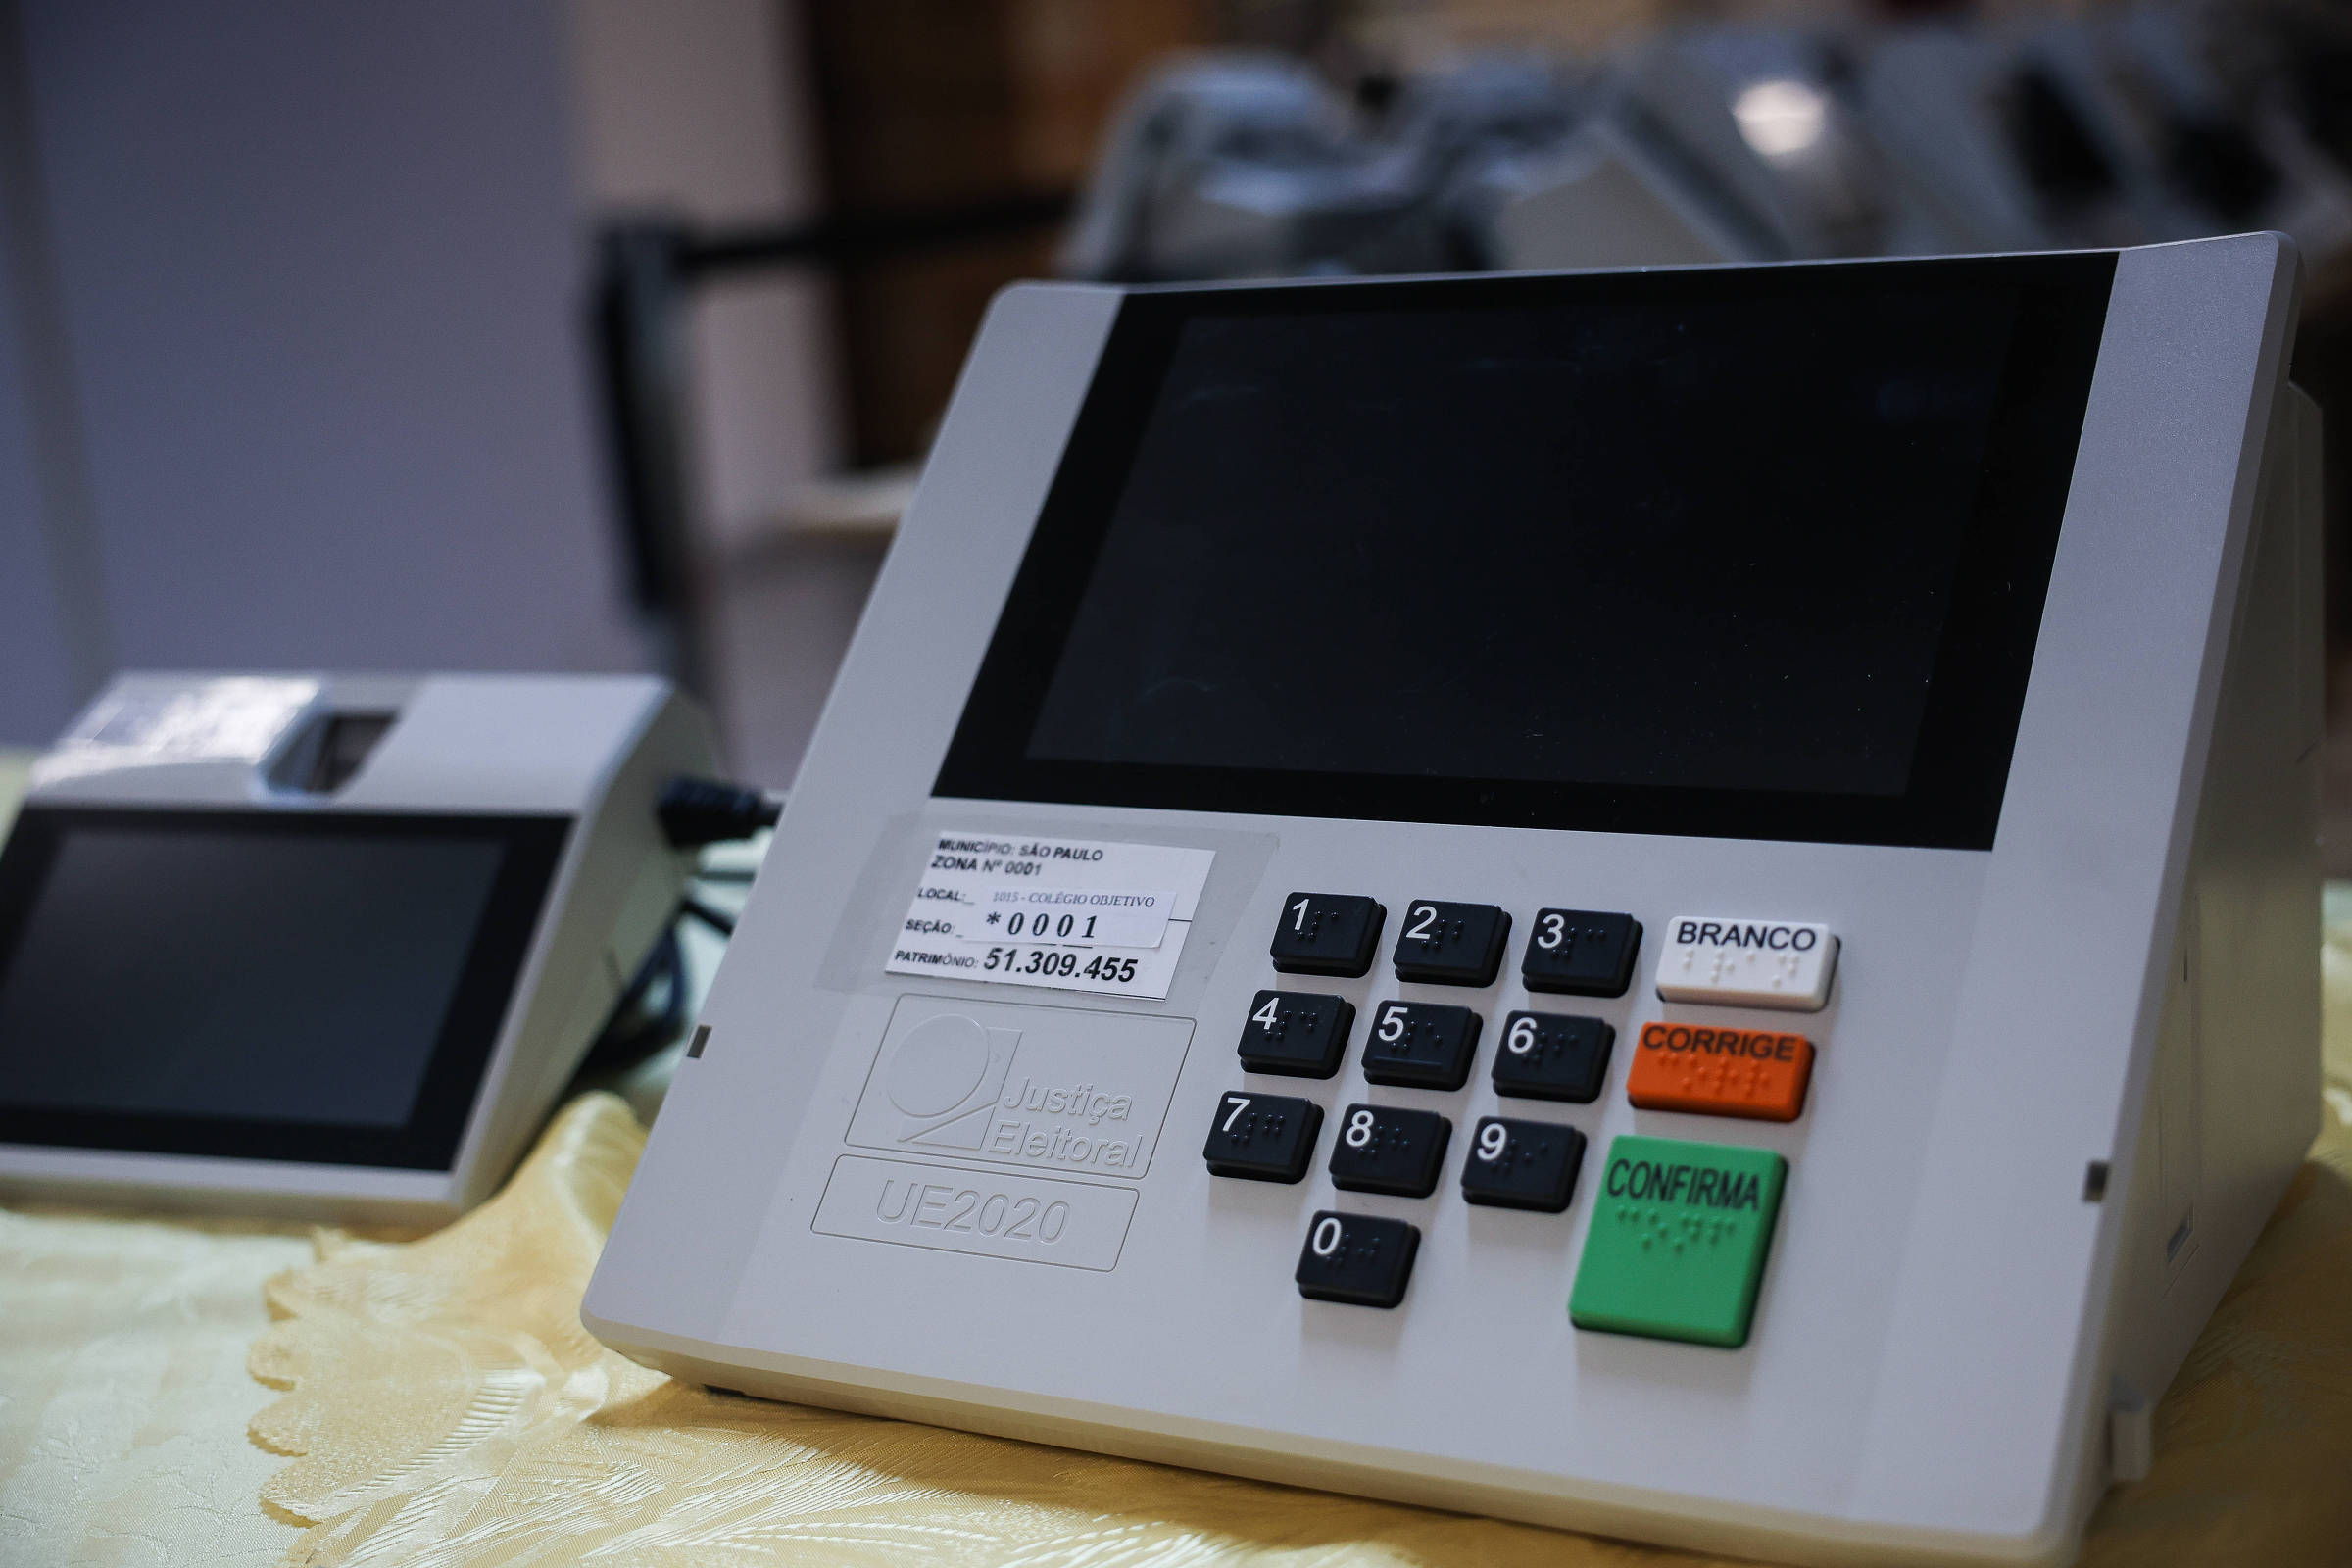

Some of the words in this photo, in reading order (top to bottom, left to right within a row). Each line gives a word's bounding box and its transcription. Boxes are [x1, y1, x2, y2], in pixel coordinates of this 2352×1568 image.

[931, 856, 978, 872] ZONA
[1004, 862, 1042, 877] 0001
[938, 838, 1016, 857] MUNICÍPIO:
[1019, 839, 1051, 858] SÃO
[1053, 845, 1104, 862] PAULO
[992, 891, 1019, 903] 1015
[1028, 890, 1088, 906] COLÉGIO
[1090, 894, 1155, 908] OBJETIVO
[1290, 899, 1309, 931] 1
[1406, 906, 1438, 939] 2
[1538, 914, 1565, 949] 3
[1676, 922, 1816, 952] BRANCO
[894, 949, 979, 968] PATRIMÔNIO:
[983, 947, 1139, 983] 51.309.455
[1252, 998, 1278, 1029] 4
[1377, 1007, 1409, 1041] 5
[1508, 1017, 1537, 1053] 6
[1642, 1026, 1797, 1062] CORRIGE
[1004, 1077, 1134, 1125] Justiça
[1220, 1098, 1250, 1132] 7
[988, 1119, 1144, 1169] Eleitoral
[1346, 1110, 1374, 1148] 8
[1477, 1124, 1507, 1160] 9
[1606, 1158, 1761, 1210] CONFIRMA
[876, 1179, 1072, 1246] UE2020
[1312, 1217, 1341, 1255] 0
